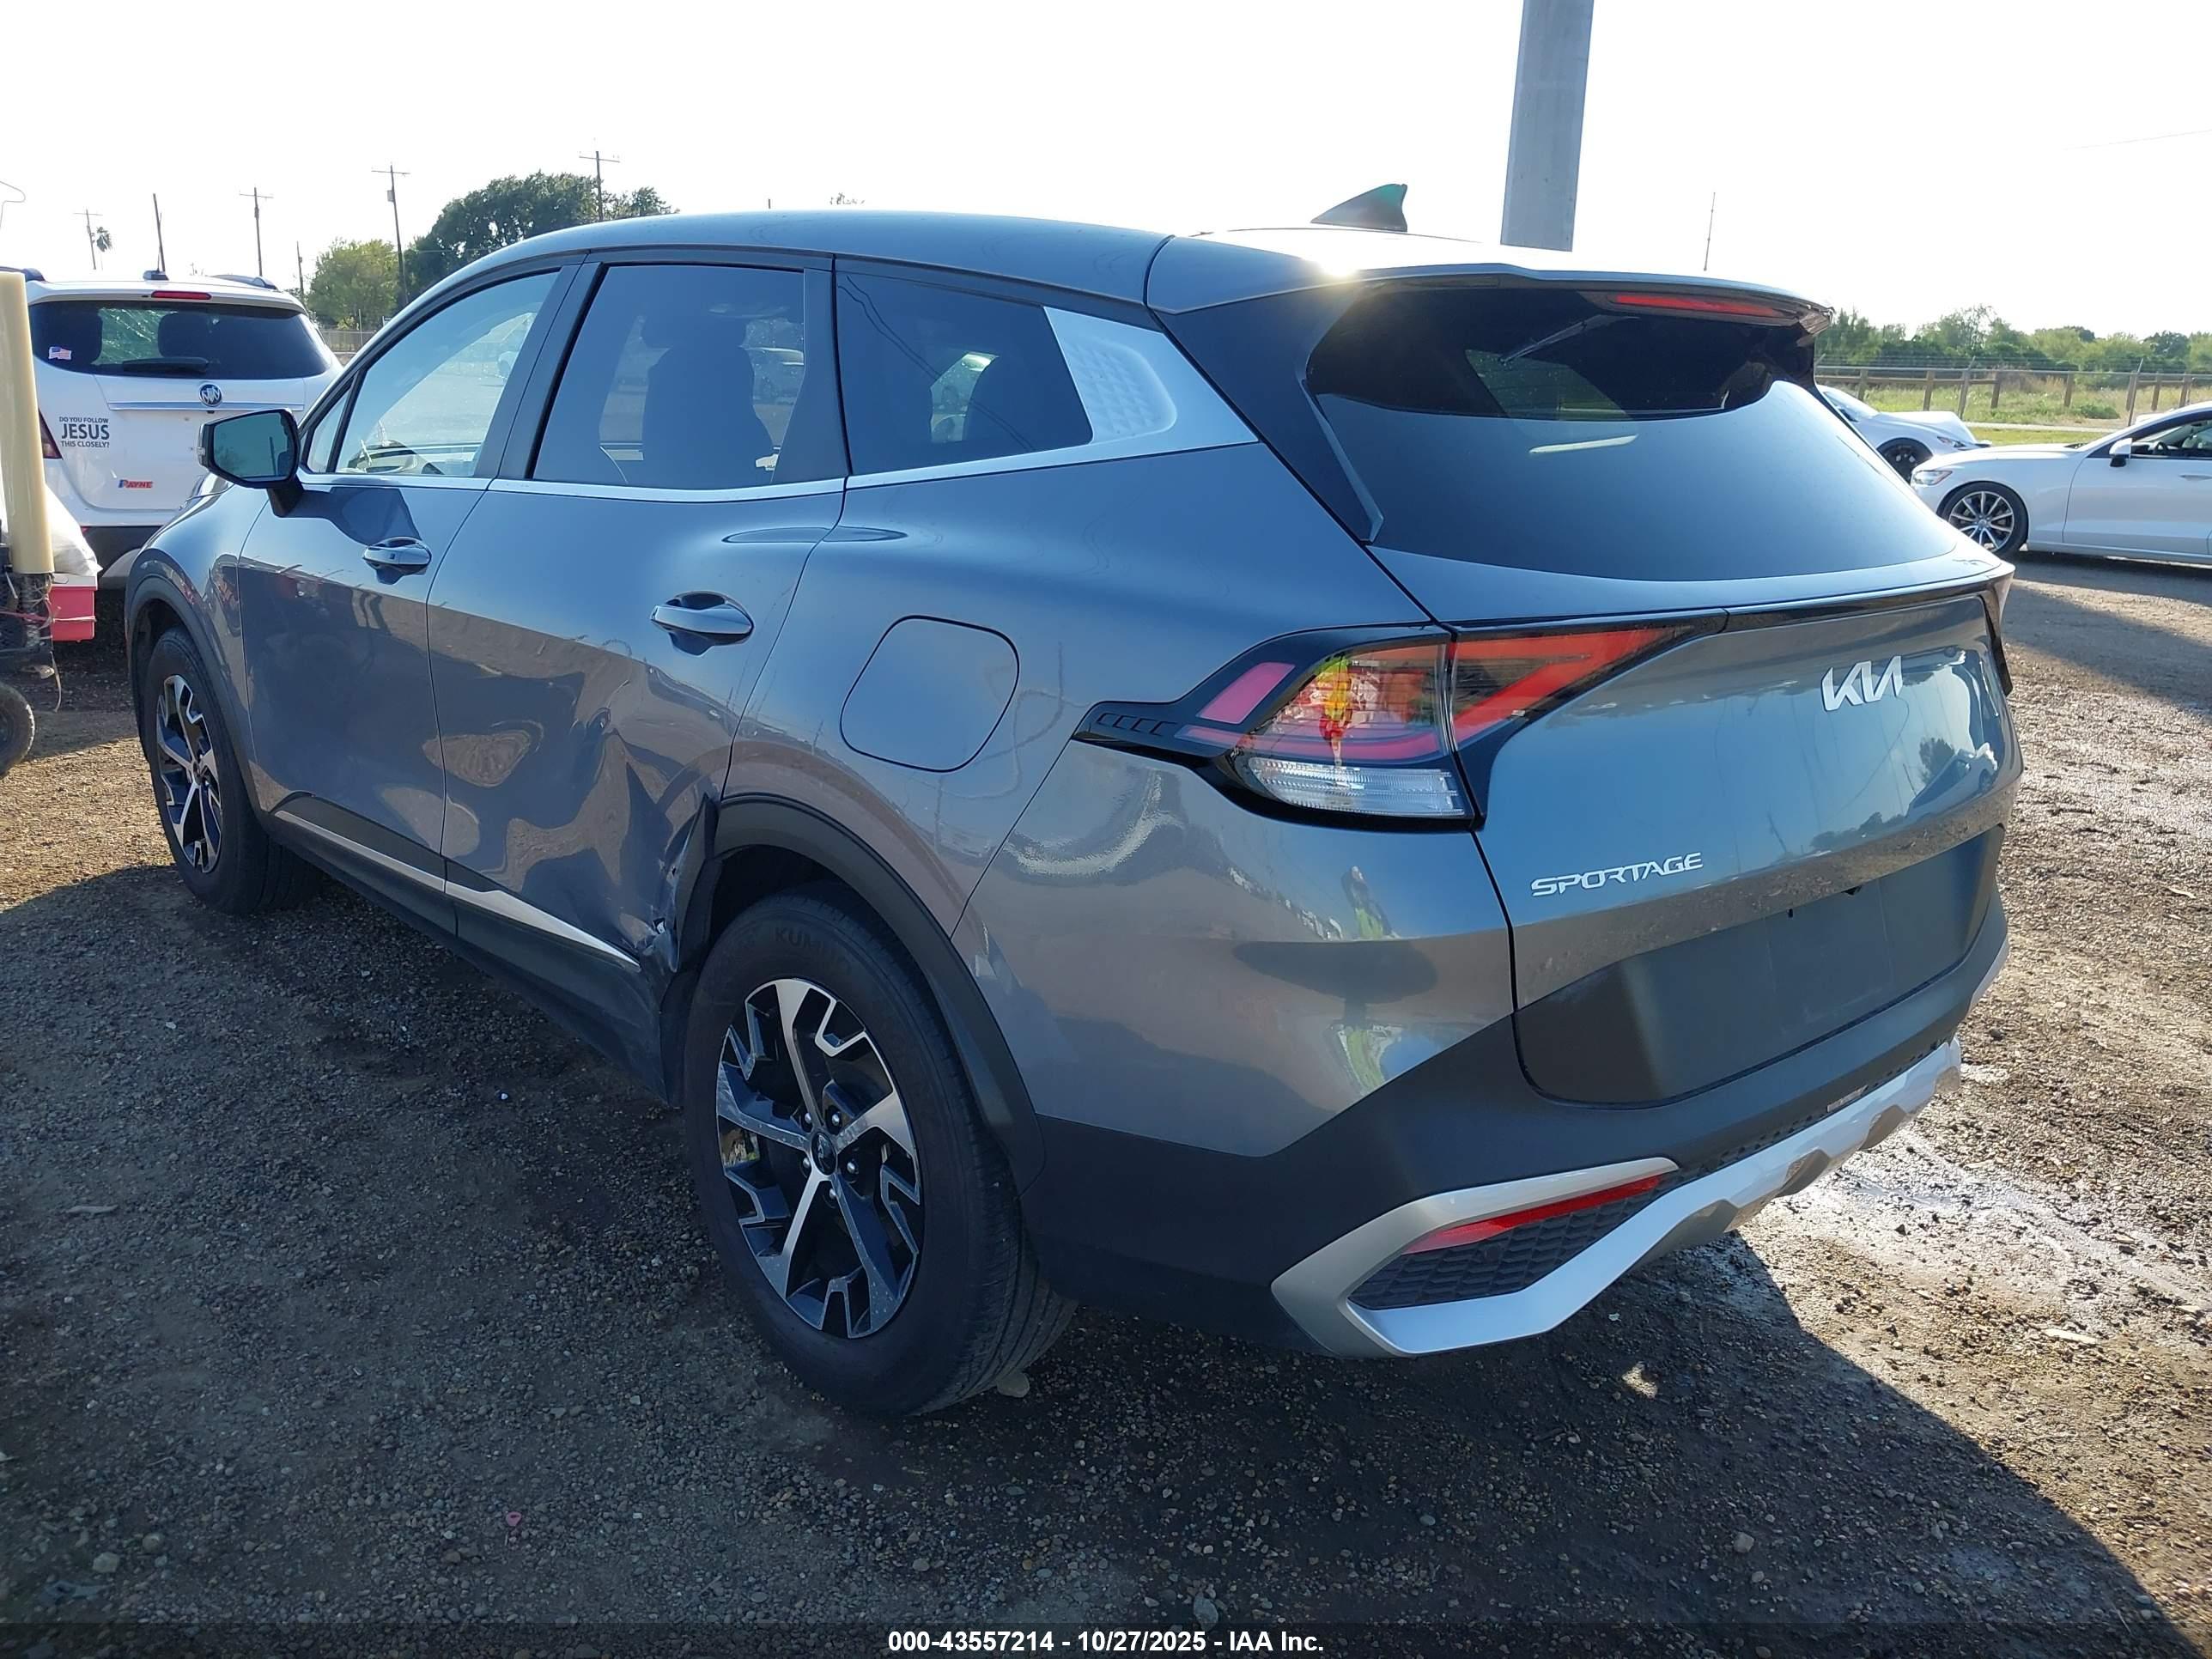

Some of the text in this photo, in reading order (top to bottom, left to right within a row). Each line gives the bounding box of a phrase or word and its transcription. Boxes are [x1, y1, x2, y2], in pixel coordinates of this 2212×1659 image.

[61, 423, 110, 441] JESUS
[1821, 655, 1903, 712] KIA
[1531, 852, 1704, 896] SPORTAGE
